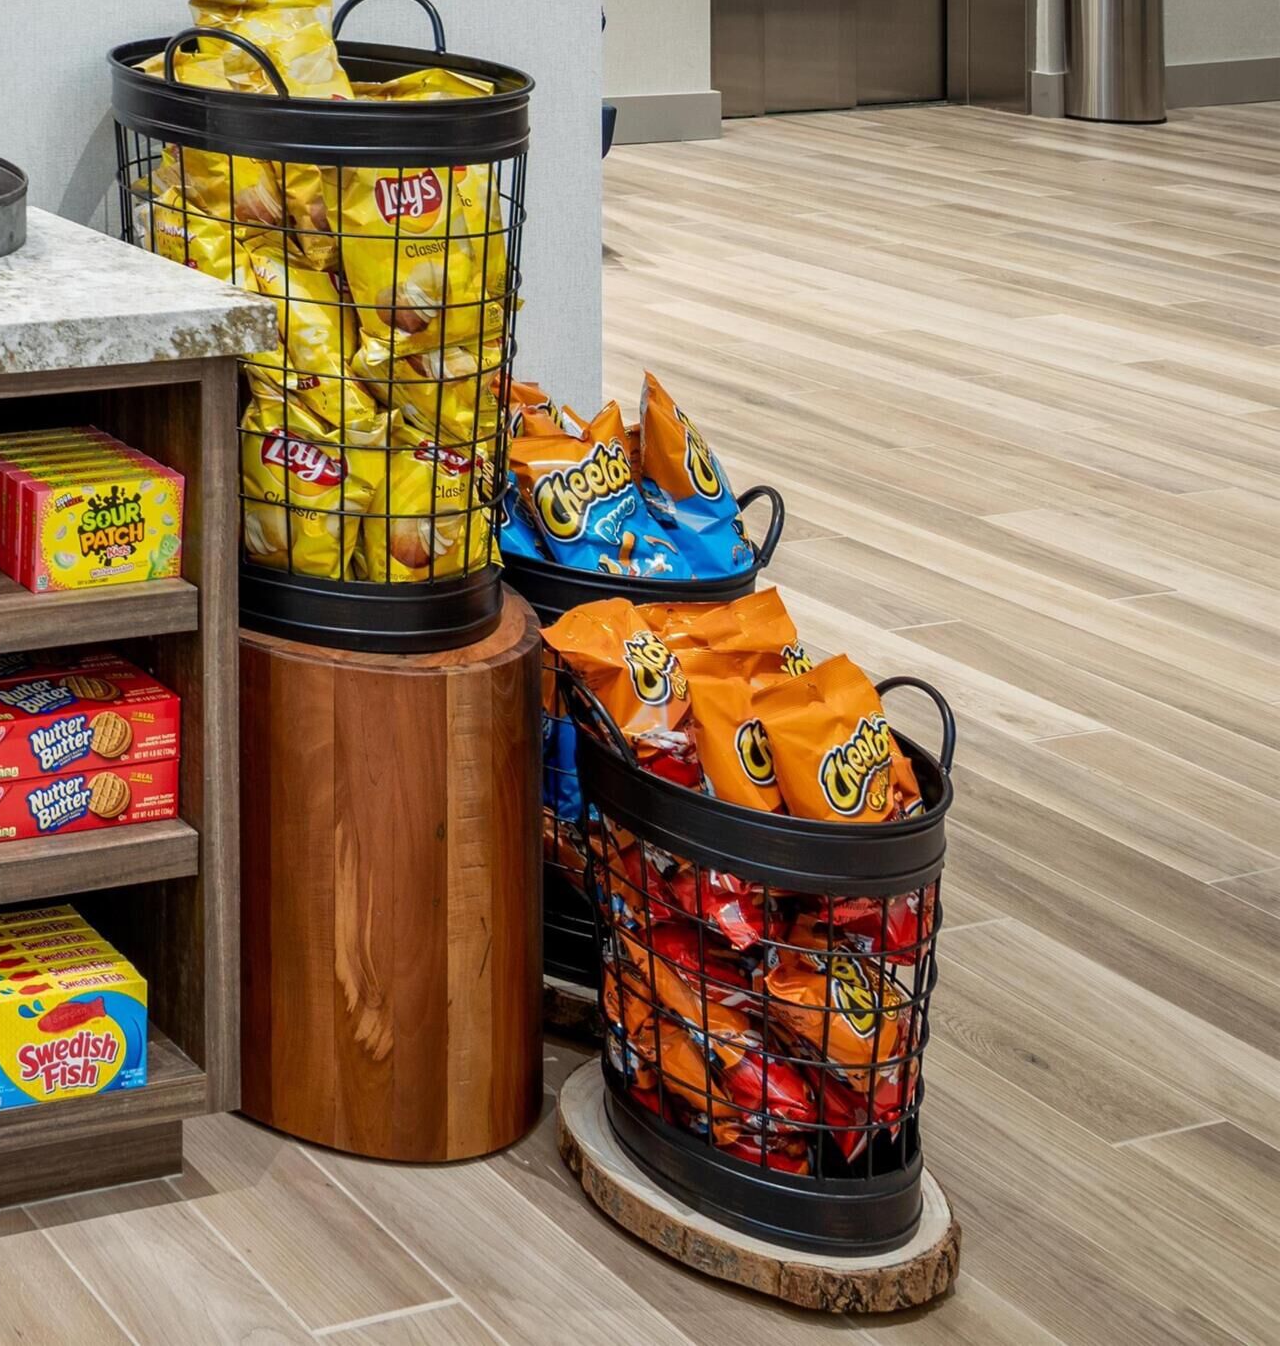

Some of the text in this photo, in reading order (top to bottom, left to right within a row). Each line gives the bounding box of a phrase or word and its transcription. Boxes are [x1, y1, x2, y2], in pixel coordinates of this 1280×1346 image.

[380, 170, 438, 218] Lay's
[265, 431, 344, 483] Lay's
[535, 442, 632, 541] Cheetos
[81, 502, 140, 532] SOUR
[80, 522, 144, 554] PATCH
[17, 686, 71, 713] Butter
[29, 715, 85, 753] Nutter
[39, 728, 93, 771] Butter
[819, 716, 893, 815] Cheetos
[28, 776, 85, 814] Nutter
[37, 790, 91, 830] Butter
[22, 934, 86, 951] Swedish Fish
[35, 946, 100, 963] Swedish Fish
[48, 959, 113, 976] Swedish Fish
[58, 973, 125, 989] Swedish Fish
[18, 1032, 118, 1079] Swedish
[41, 1059, 98, 1093] Fish
